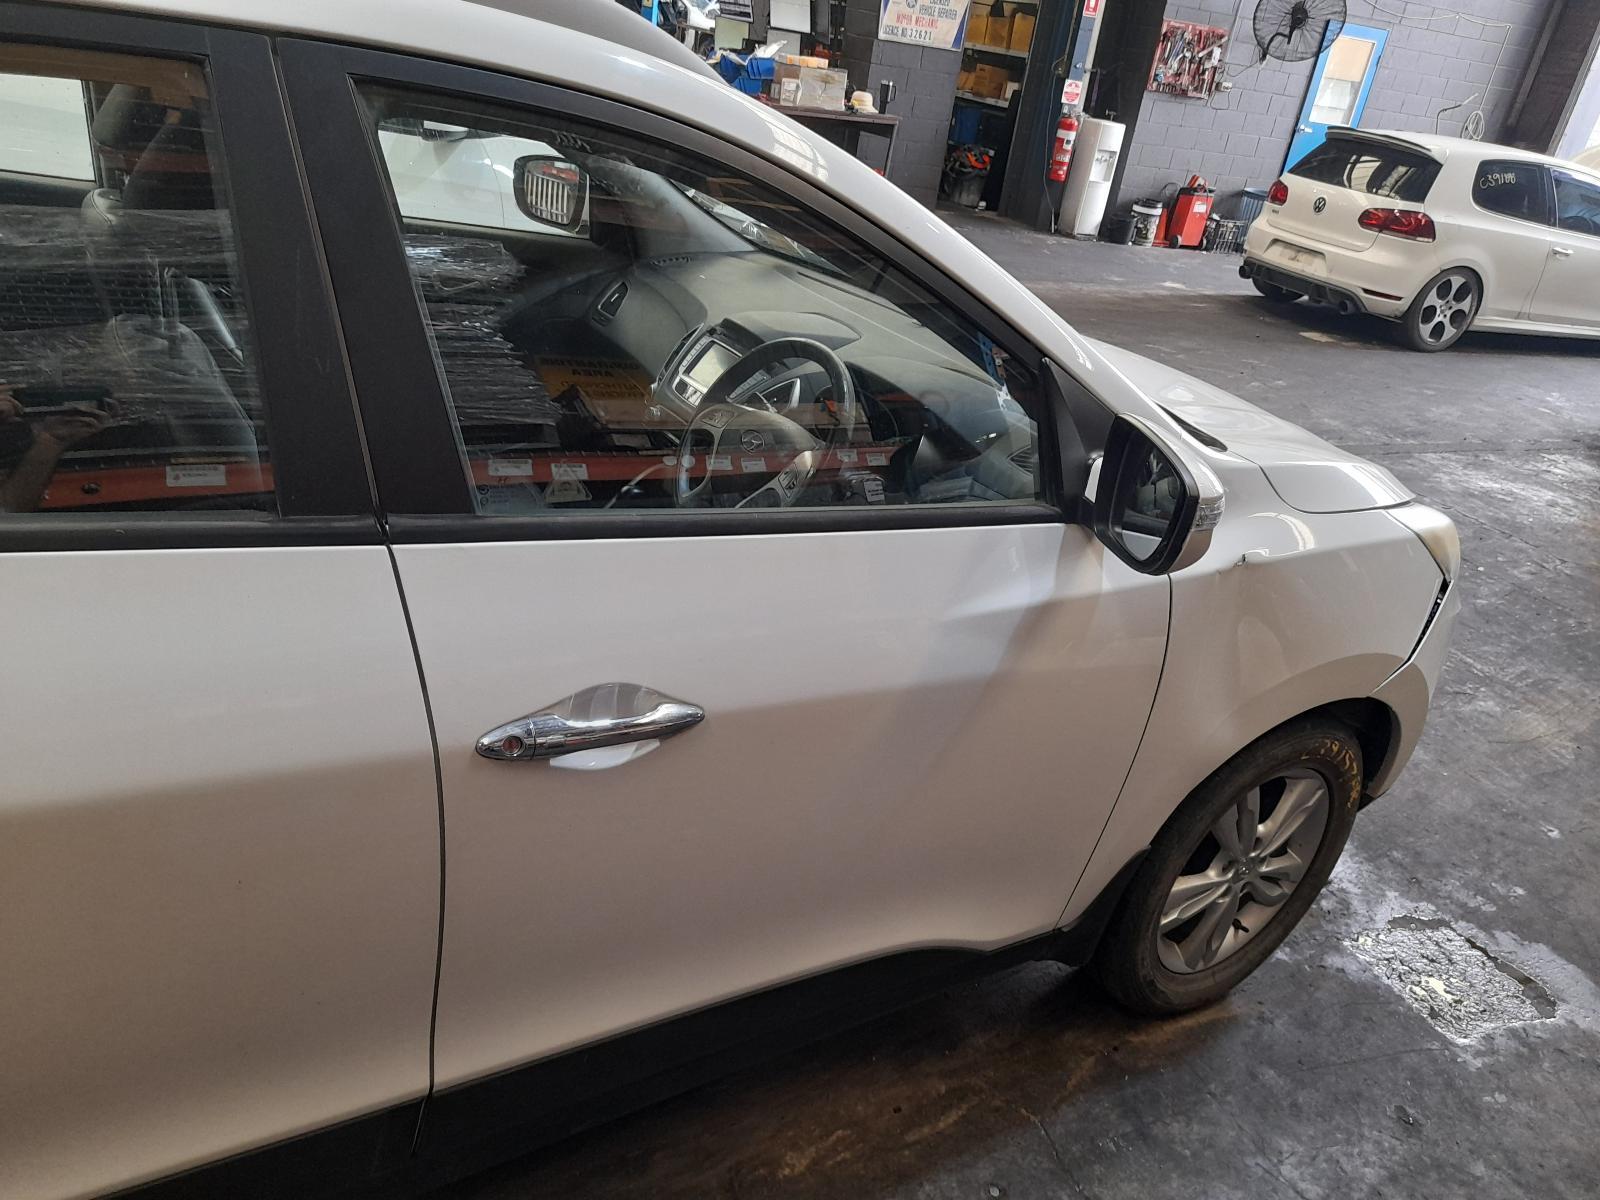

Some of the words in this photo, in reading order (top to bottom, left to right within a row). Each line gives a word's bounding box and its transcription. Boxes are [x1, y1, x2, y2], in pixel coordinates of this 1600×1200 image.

[919, 4, 936, 17] VEHICLE
[937, 6, 957, 20] REPAIRER
[896, 12, 913, 26] MOTOR
[914, 15, 940, 29] MECHANIC
[908, 28, 932, 41] 32621
